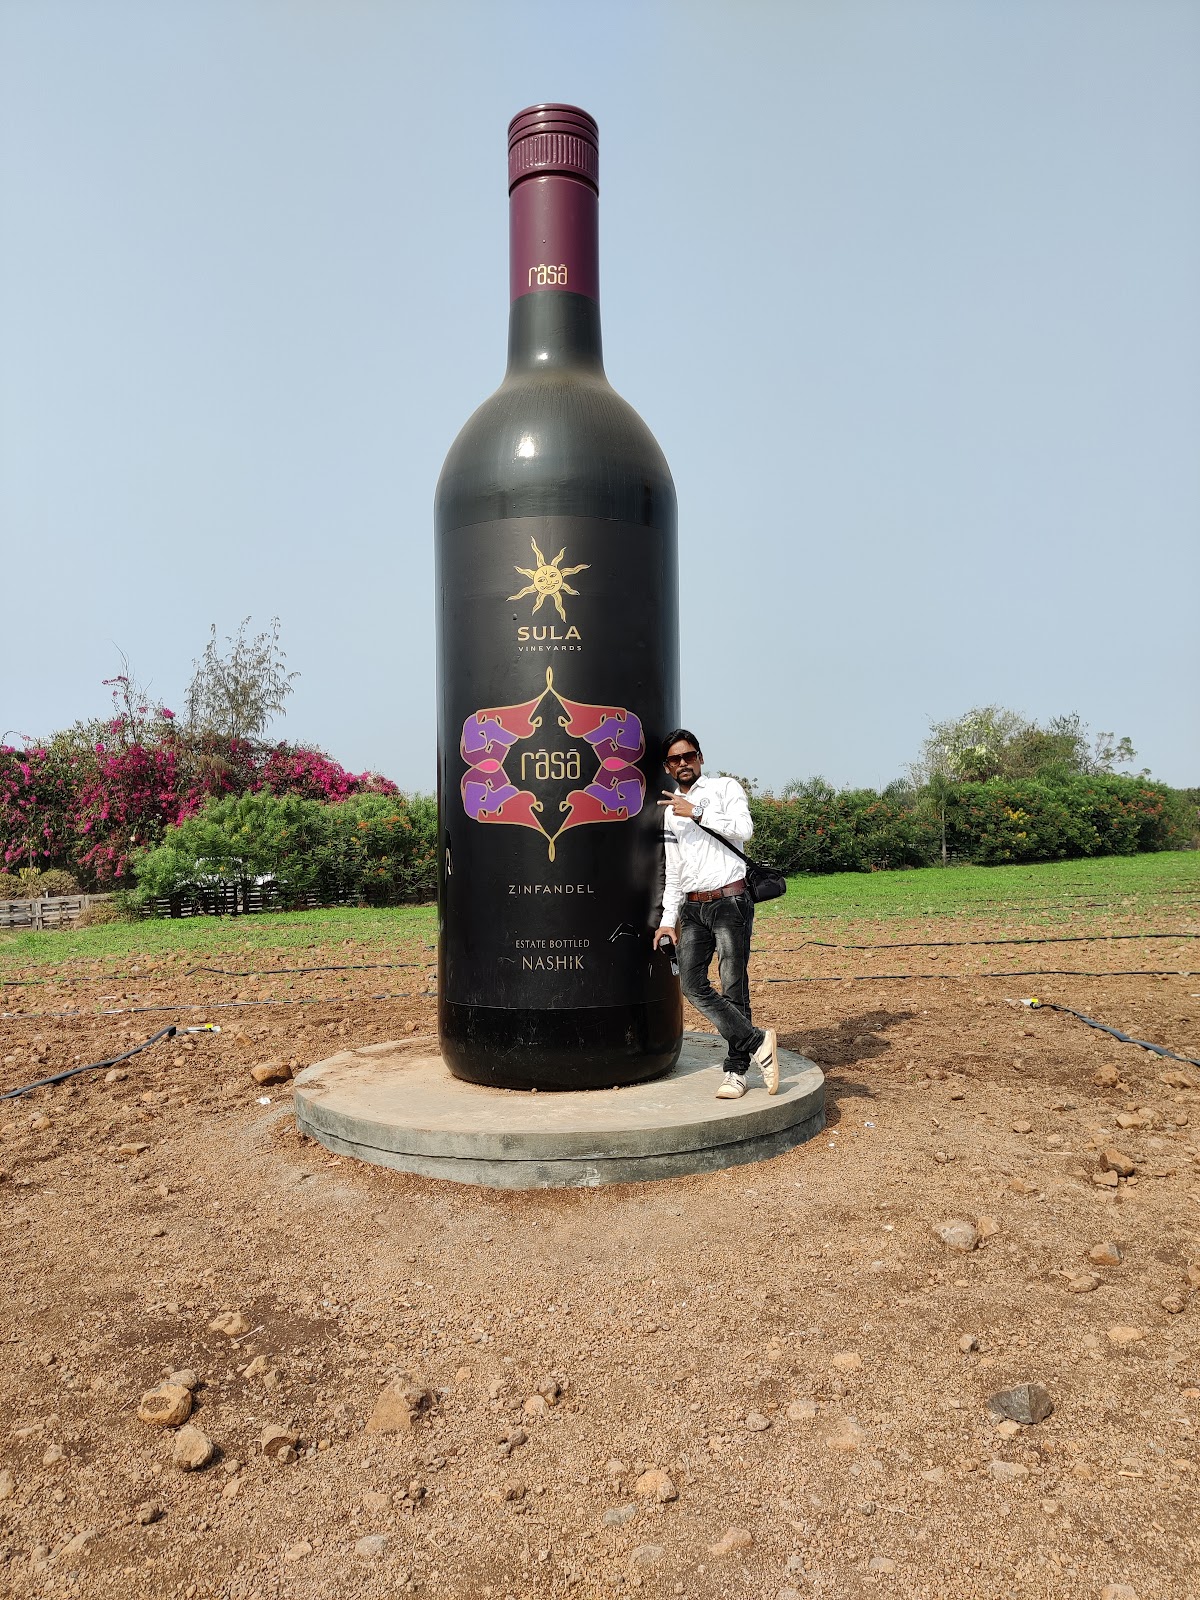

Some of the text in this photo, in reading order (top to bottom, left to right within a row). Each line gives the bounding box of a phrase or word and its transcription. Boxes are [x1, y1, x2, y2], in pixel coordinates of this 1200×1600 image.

[517, 625, 582, 641] SULA
[508, 884, 595, 895] ZINFANDEL
[515, 939, 590, 948] ESTATE BOTTLED
[522, 955, 584, 970] NASHIK
